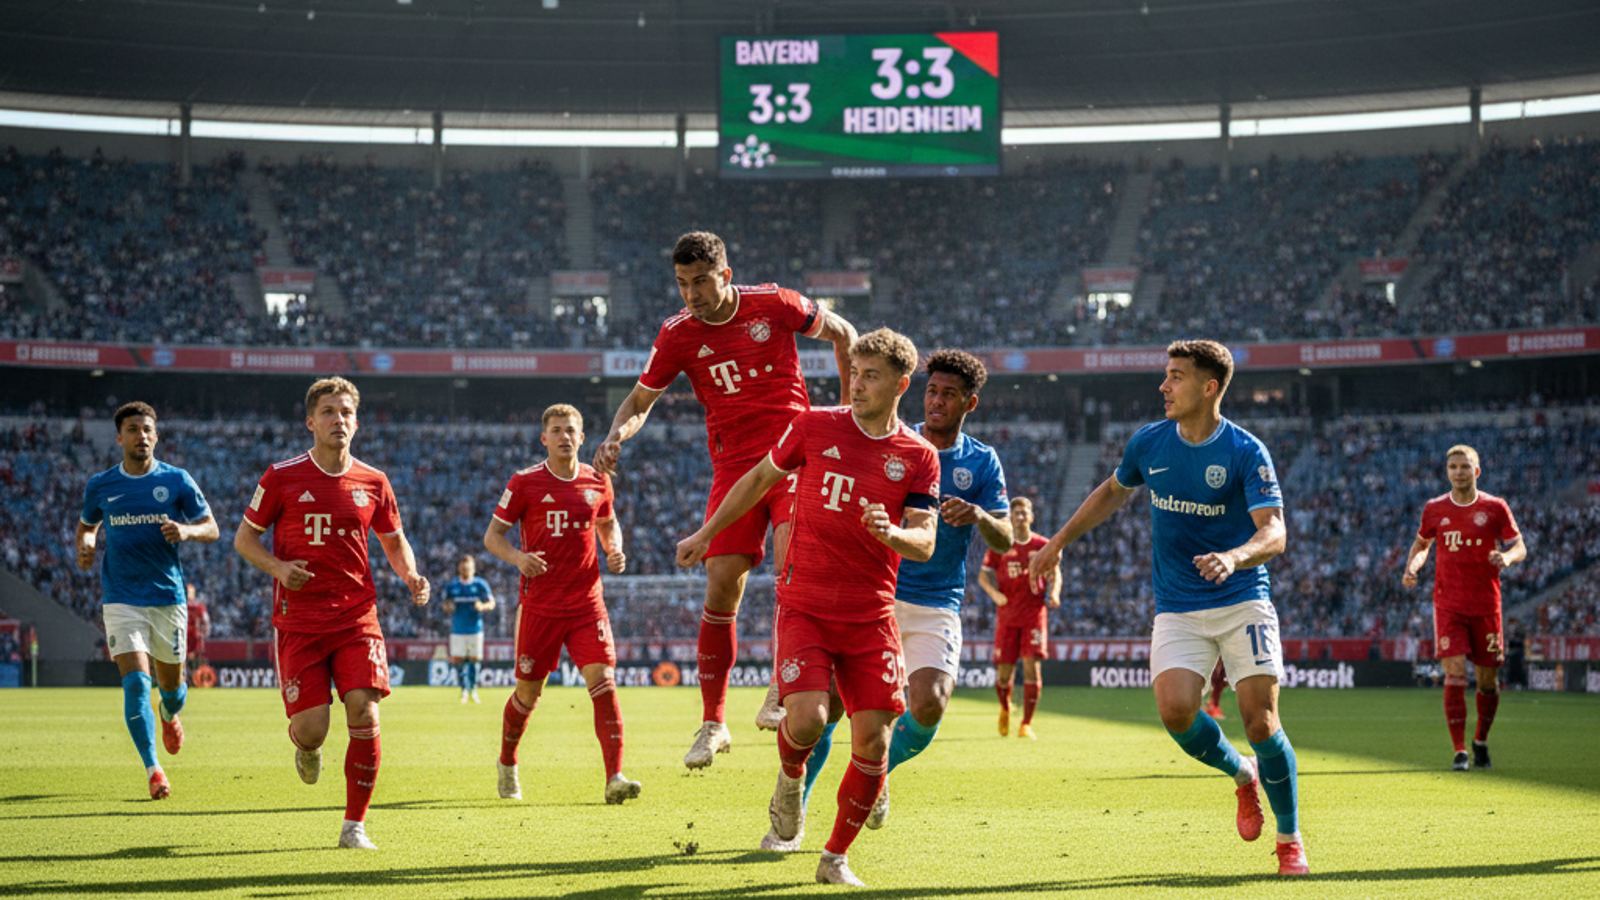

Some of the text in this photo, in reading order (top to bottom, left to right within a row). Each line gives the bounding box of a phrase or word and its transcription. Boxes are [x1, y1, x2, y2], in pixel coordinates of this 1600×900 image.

[736, 40, 819, 65] BAYERN
[871, 46, 955, 100] 3:3
[749, 83, 812, 124] 3:3
[843, 106, 983, 134] HEIDENHEIM
